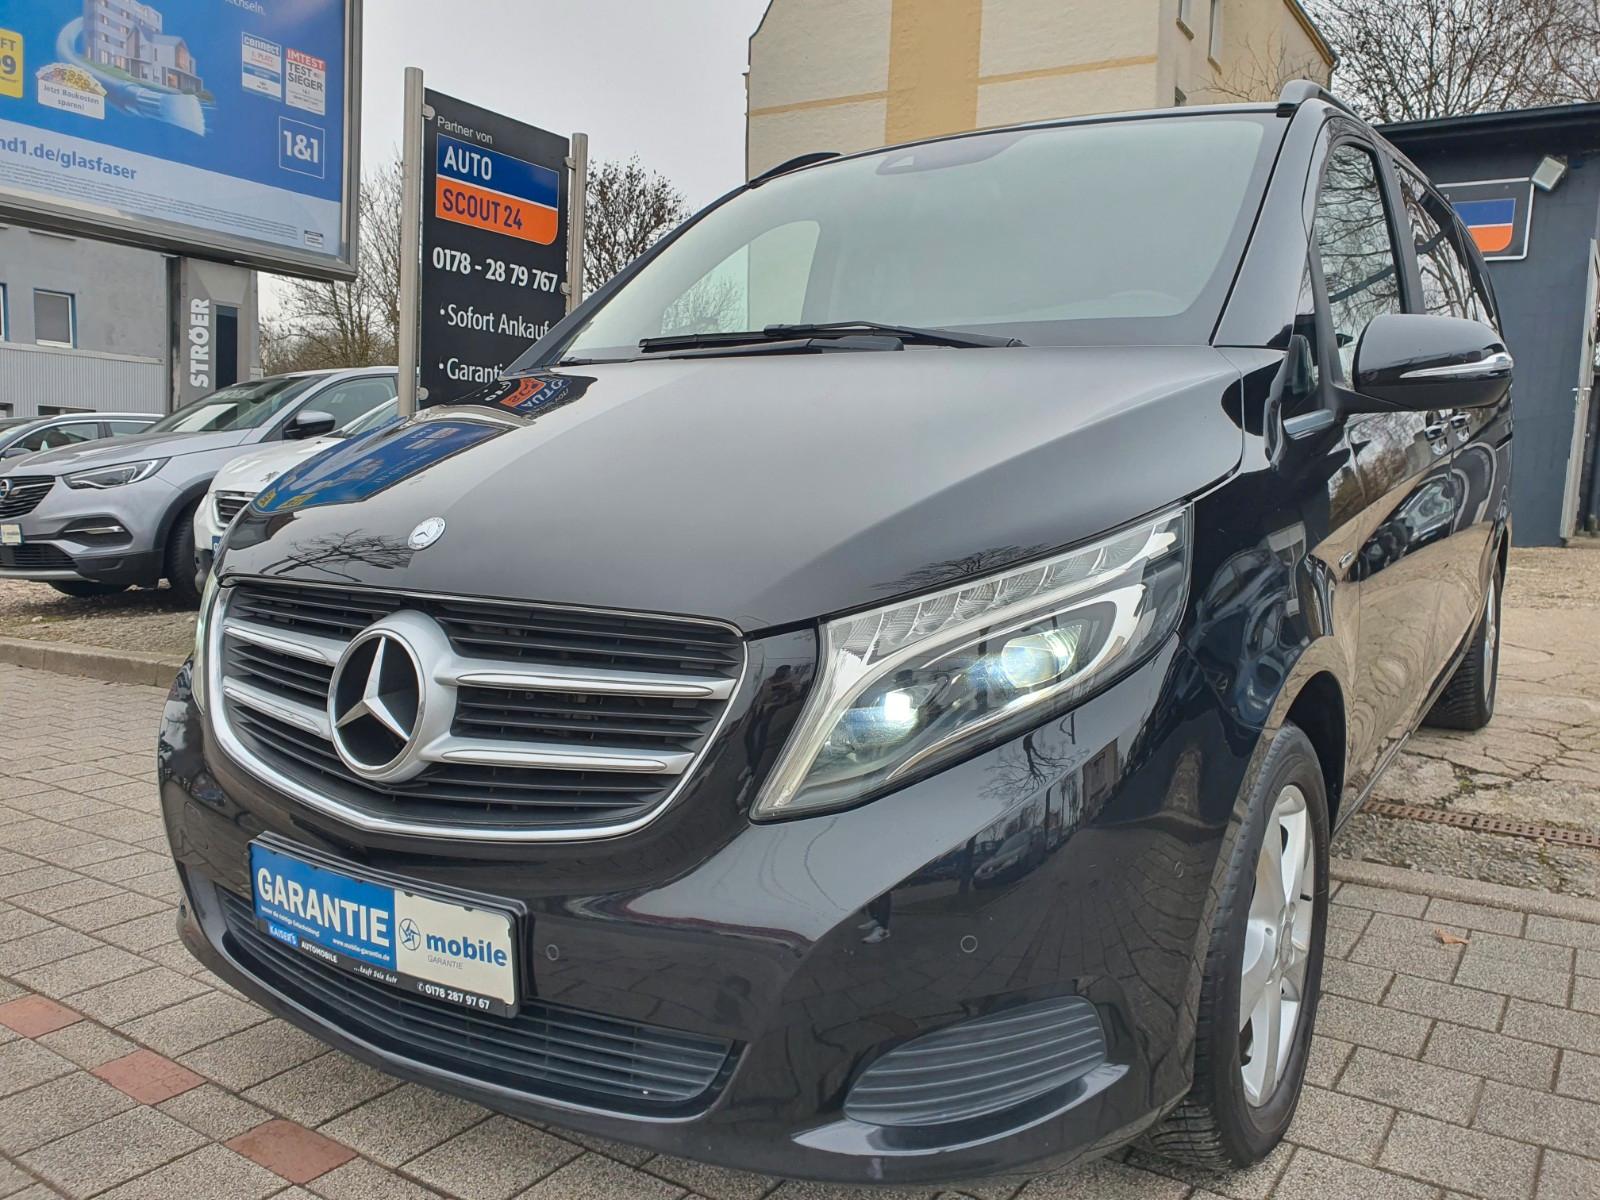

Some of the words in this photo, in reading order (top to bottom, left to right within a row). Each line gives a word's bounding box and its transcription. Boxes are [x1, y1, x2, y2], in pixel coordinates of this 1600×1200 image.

[244, 36, 280, 56] connect
[287, 49, 324, 70] IMTEST
[288, 61, 312, 77] TEST
[44, 83, 60, 94] Jetzt
[62, 89, 100, 105] Baukosten
[288, 73, 323, 92] SIEGER
[58, 99, 85, 111] sparen!
[437, 115, 474, 138] Partner
[476, 130, 493, 145] von
[283, 130, 319, 163] 1&1
[443, 145, 492, 181] AUTO
[432, 247, 471, 275] 0178
[485, 258, 506, 282] 28
[509, 264, 528, 287] 79
[532, 269, 558, 293] 767
[498, 313, 550, 340] Ankauf
[188, 298, 209, 388] STRÖER
[257, 868, 390, 948] GARANTIE
[301, 940, 338, 963] AUTOMOBILE
[426, 933, 508, 967] mobile
[427, 954, 464, 970] GARANTIE
[425, 984, 445, 998] 0178
[447, 990, 463, 1003] 287
[465, 995, 477, 1006] 97
[478, 998, 490, 1010] 67
